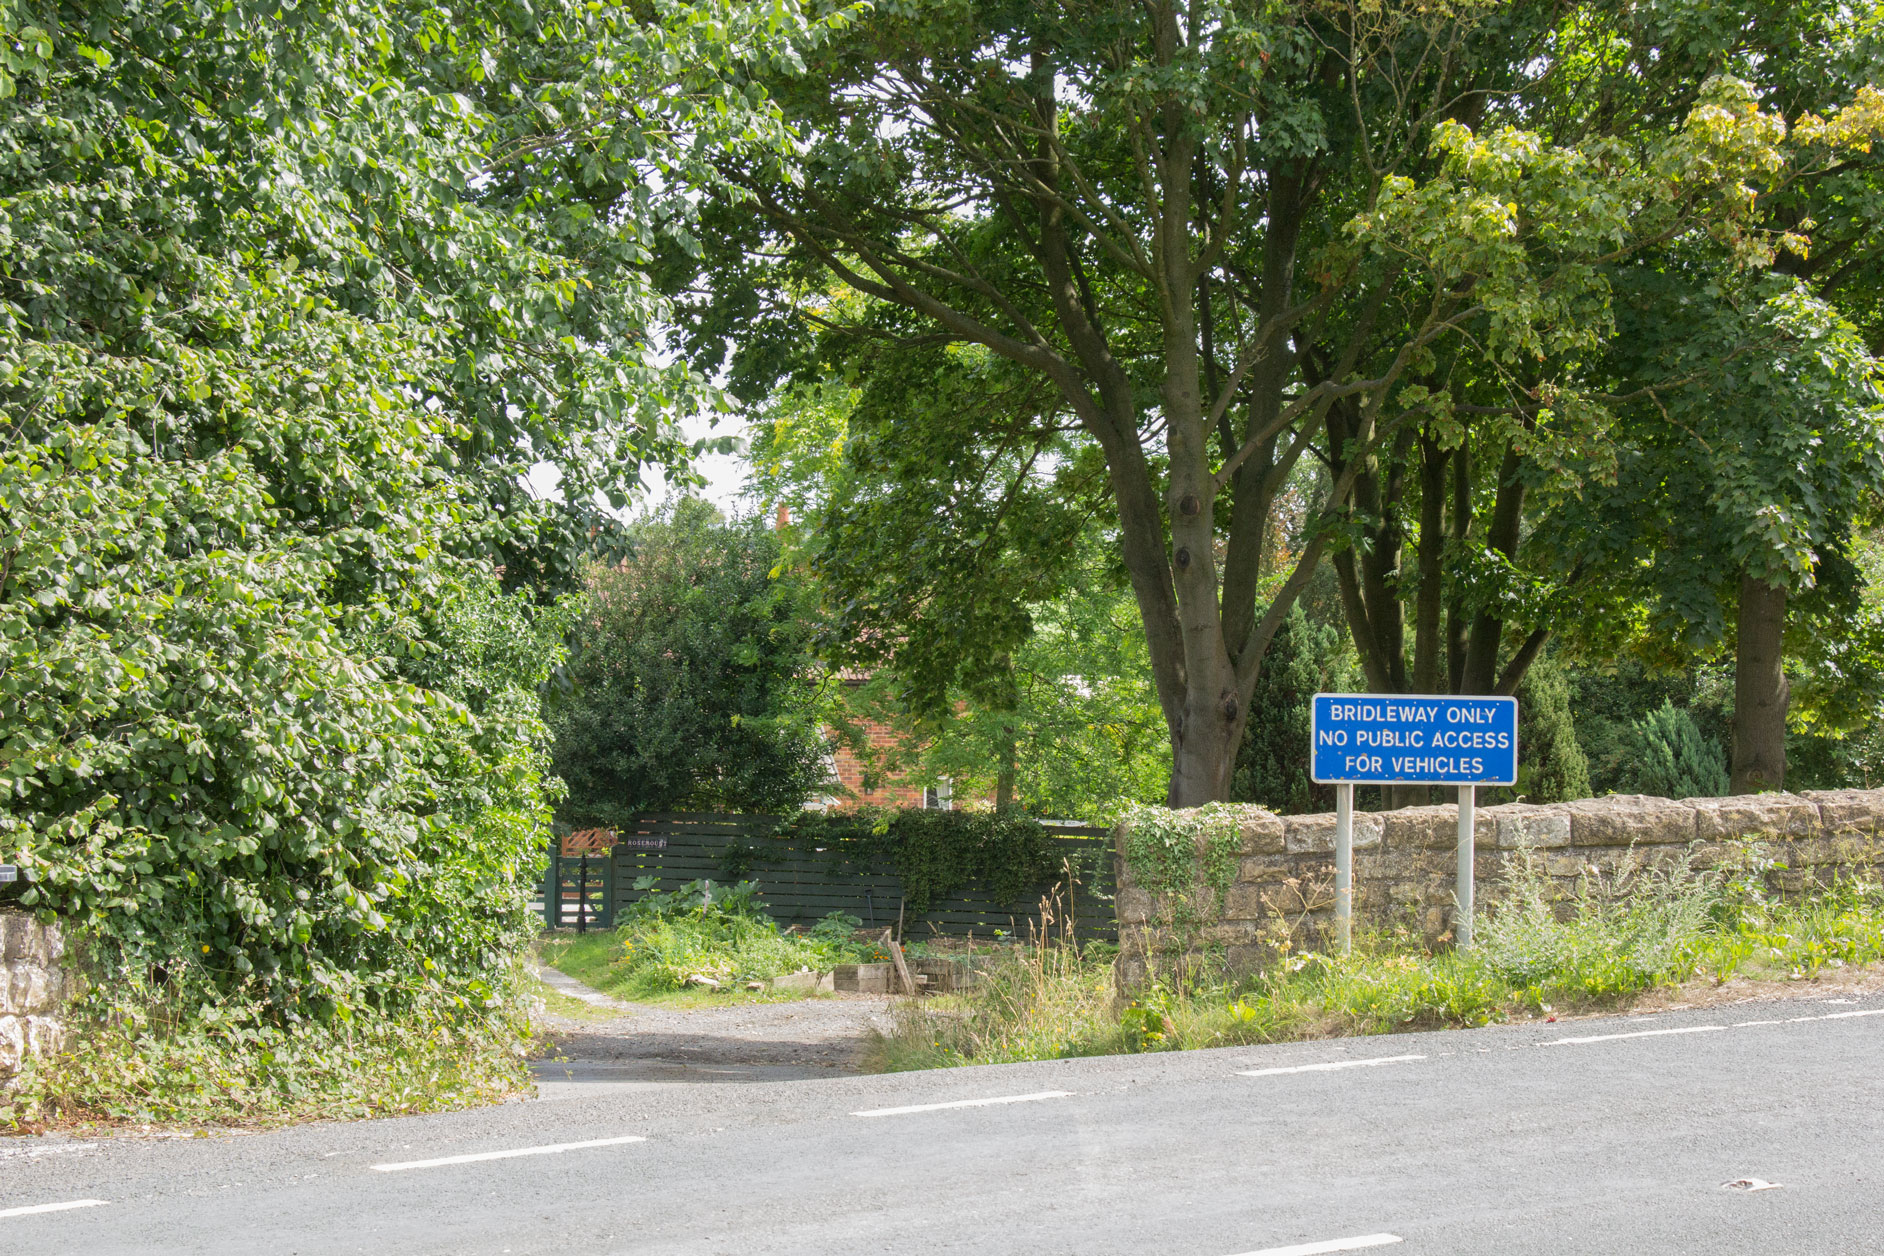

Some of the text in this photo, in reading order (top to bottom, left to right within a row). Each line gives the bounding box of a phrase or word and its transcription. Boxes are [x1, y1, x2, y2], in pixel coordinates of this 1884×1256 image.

[1331, 704, 1496, 723] BRIDLEWAY ONLY
[1319, 729, 1510, 748] NO PUBLIC ACCESS
[1345, 756, 1484, 773] FOR VEHICLES
[627, 839, 667, 847] ROSEMOUT
